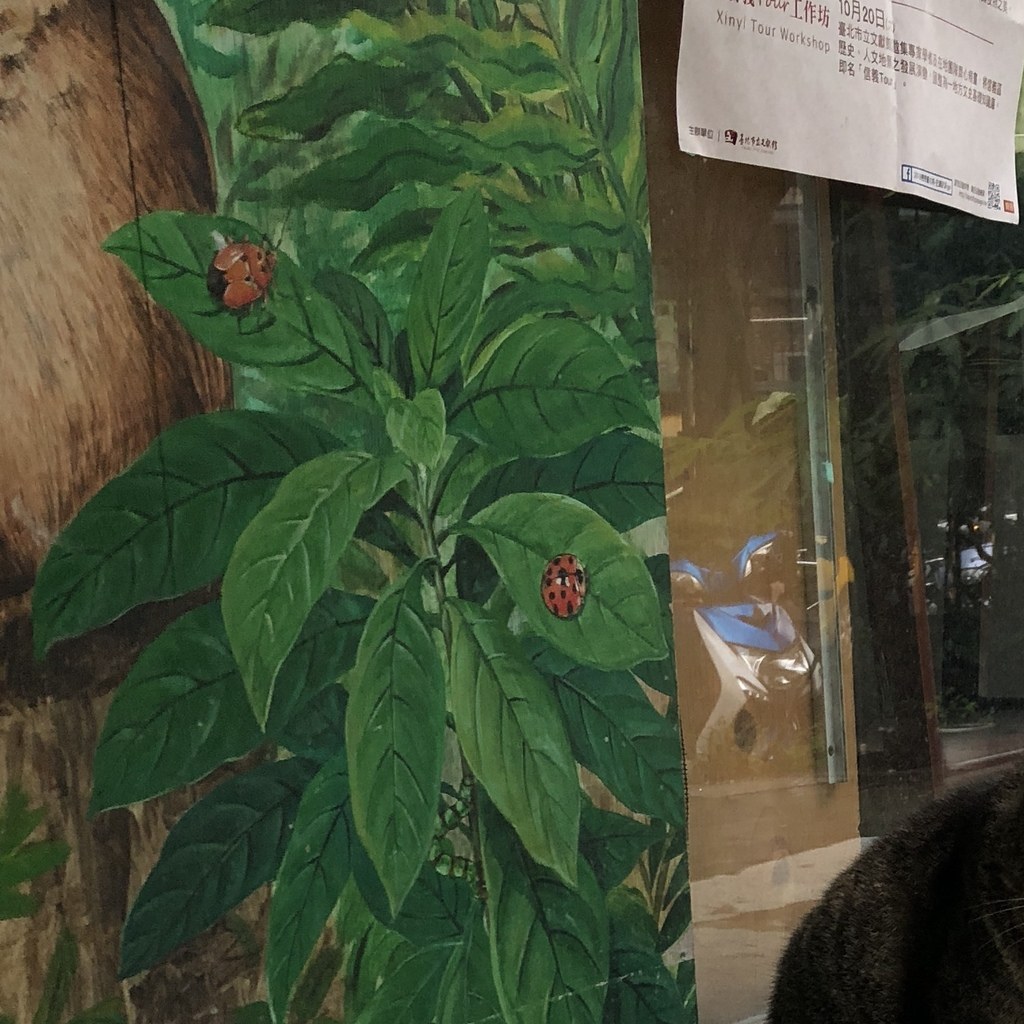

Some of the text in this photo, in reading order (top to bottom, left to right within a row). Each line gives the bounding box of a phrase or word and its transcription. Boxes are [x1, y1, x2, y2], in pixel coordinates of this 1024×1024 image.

[717, 9, 831, 54] Xinyi Tour Workshop
